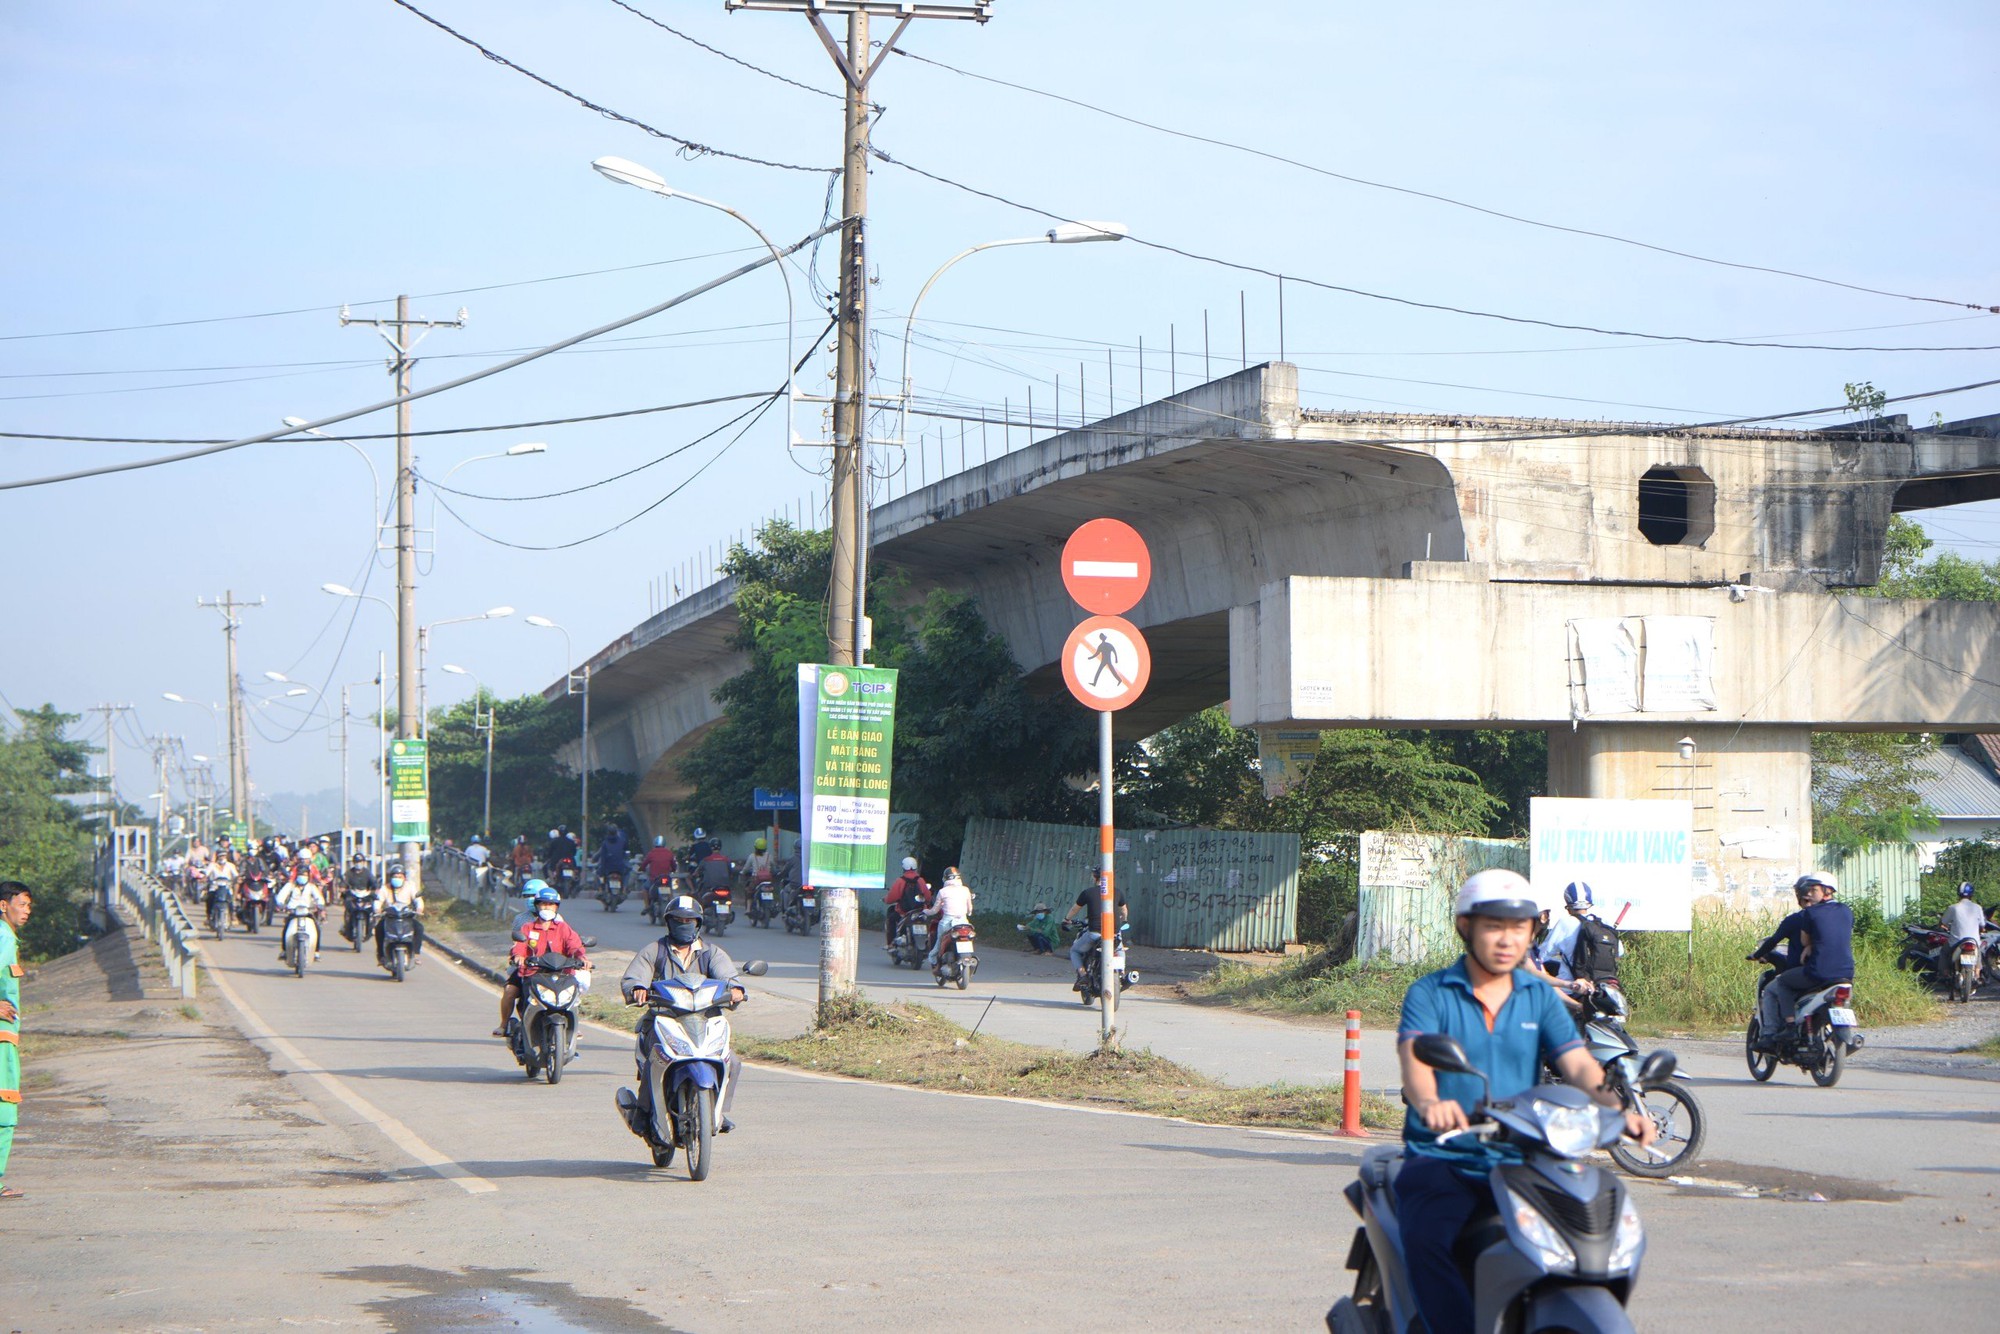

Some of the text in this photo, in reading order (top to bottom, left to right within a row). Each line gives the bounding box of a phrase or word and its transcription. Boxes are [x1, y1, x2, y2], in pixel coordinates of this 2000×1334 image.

[852, 682, 886, 694] TCIP
[861, 731, 883, 742] GIAO
[830, 744, 851, 758] MẶT
[840, 761, 854, 772] THI
[856, 761, 881, 774] CÔNG
[838, 776, 861, 788] TĂNG
[863, 779, 888, 790] LONG
[1602, 830, 1639, 864] NAM
[1643, 830, 1687, 864] VANG
